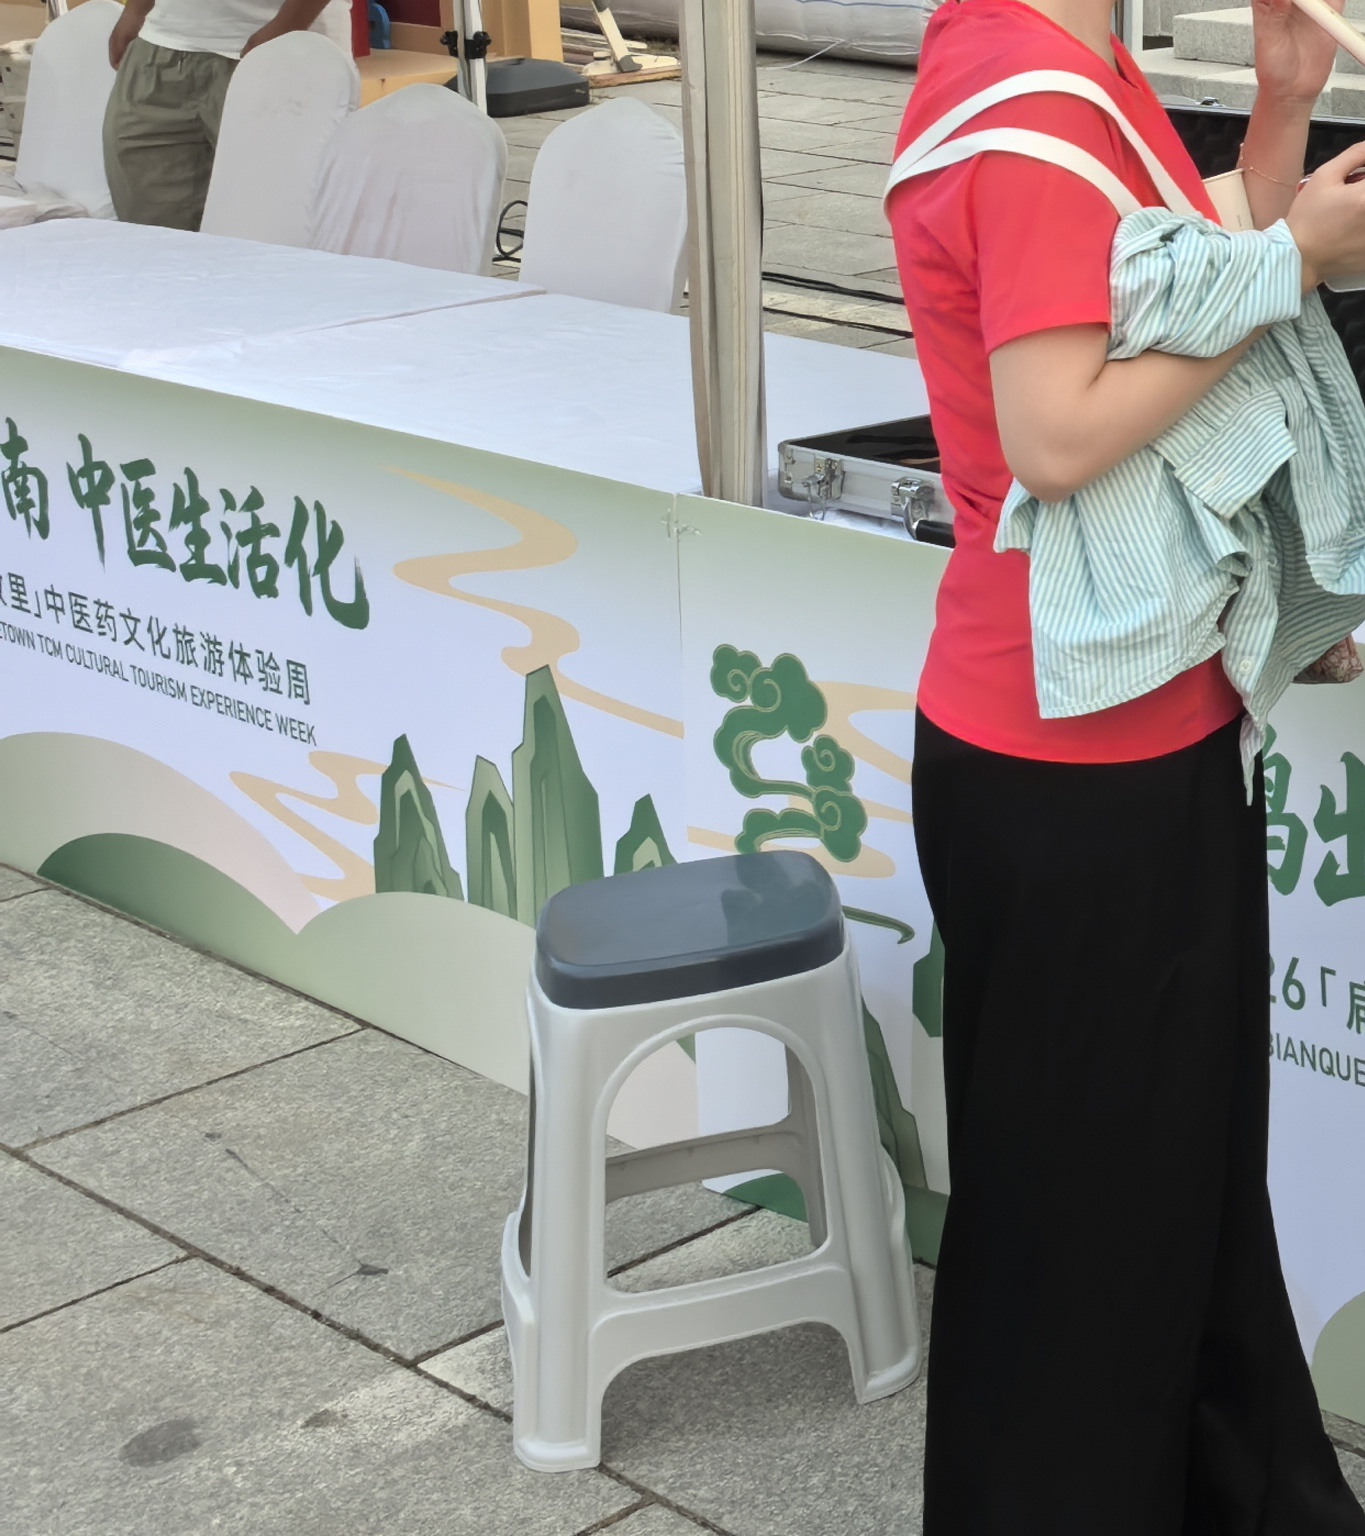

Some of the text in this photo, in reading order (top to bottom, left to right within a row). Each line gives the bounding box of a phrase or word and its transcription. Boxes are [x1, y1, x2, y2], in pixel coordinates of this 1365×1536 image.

[66, 433, 370, 630] 中医生活化
[0, 571, 310, 705] 里」中医药文化旅游体验周
[37, 633, 63, 660] TCM
[65, 643, 129, 682] CULTURAL
[130, 664, 187, 702] TOURISM
[190, 685, 274, 732] EXPERIENCE
[275, 712, 318, 746] WEEK
